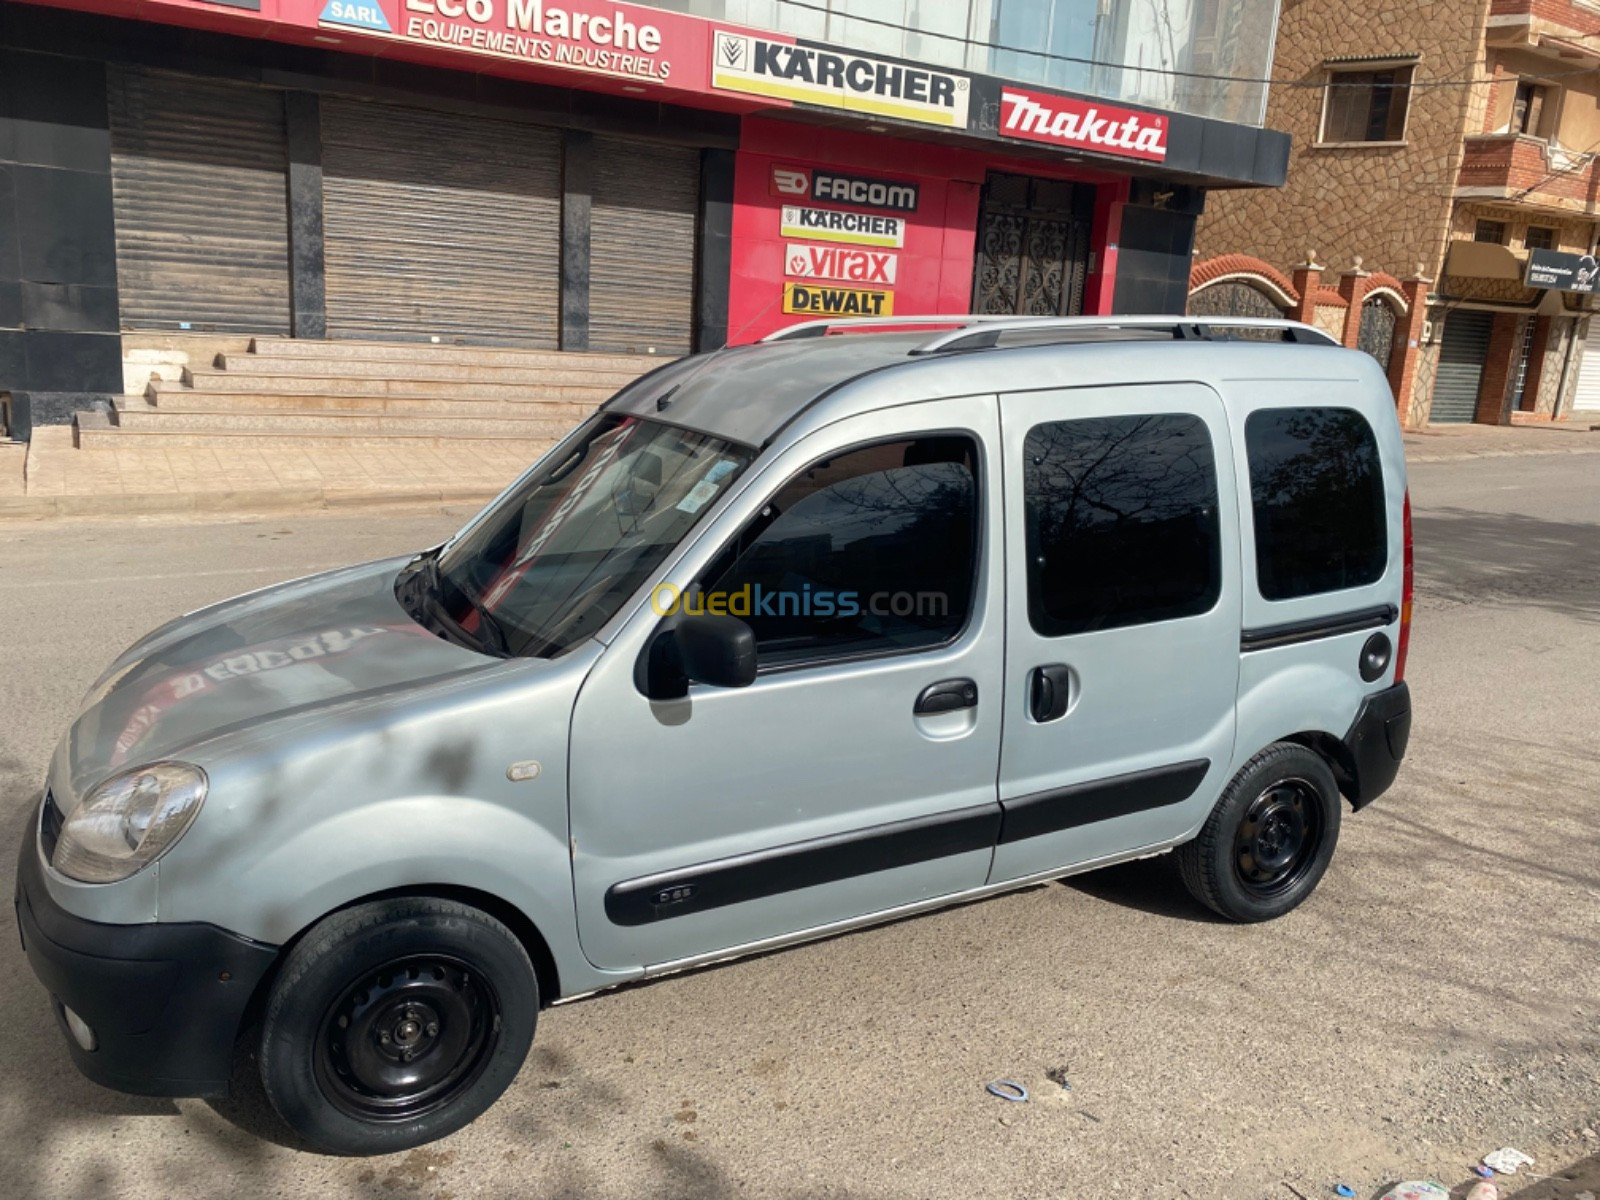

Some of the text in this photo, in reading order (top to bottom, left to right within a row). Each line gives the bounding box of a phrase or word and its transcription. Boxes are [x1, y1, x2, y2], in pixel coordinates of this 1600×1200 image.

[330, 1, 383, 25] SARL
[507, 0, 662, 53] Marche
[406, 17, 671, 80] EQUIPEMENTS INDUSTRIELS
[815, 176, 916, 209] FACOM
[800, 208, 898, 236] KÄRCHER
